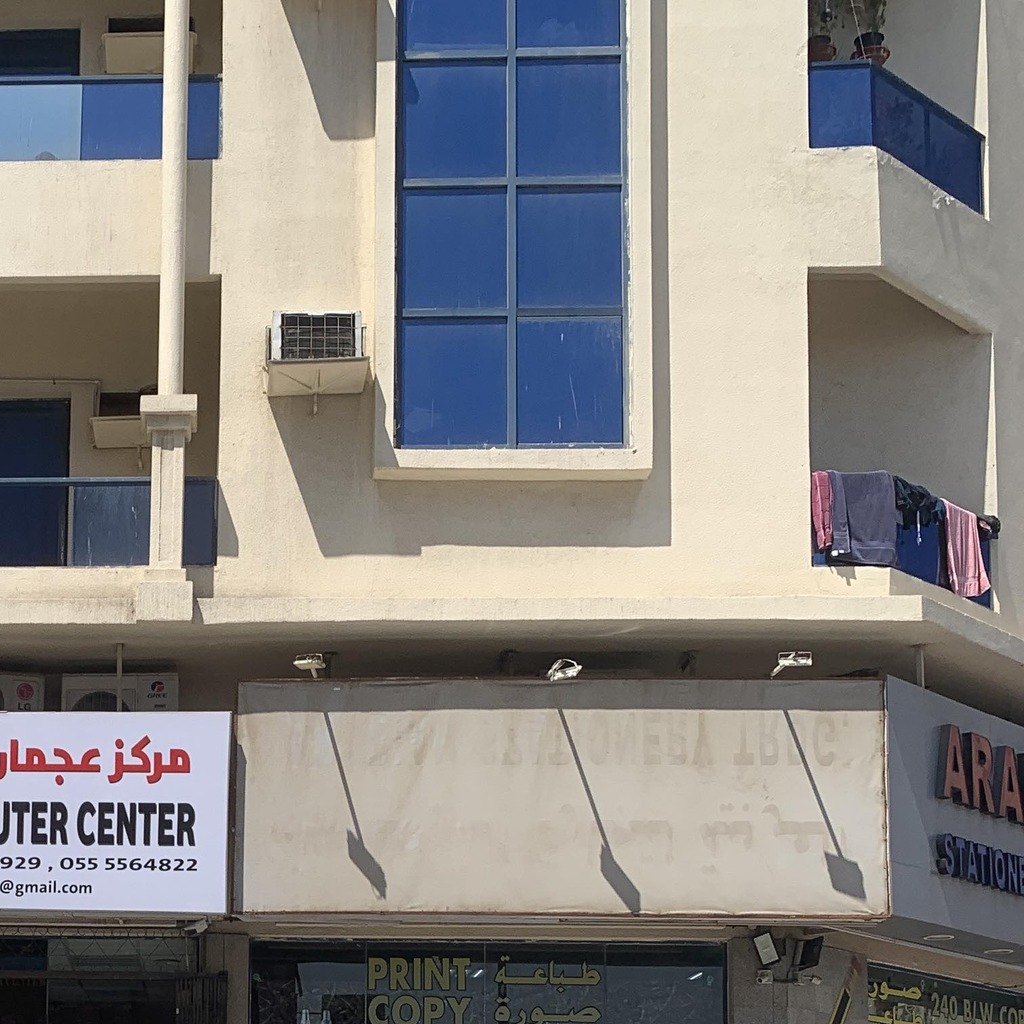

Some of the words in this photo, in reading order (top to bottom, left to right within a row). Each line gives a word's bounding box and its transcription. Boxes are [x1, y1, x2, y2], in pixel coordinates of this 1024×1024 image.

[17, 701, 32, 711] LG
[107, 734, 191, 784] مركز
[77, 801, 196, 847] CENTER
[59, 856, 98, 871] 055
[104, 857, 198, 872] 5564822
[367, 956, 471, 991] PRINT
[494, 955, 602, 994] طباعة
[868, 981, 922, 1000] صور
[931, 992, 958, 1020] 240
